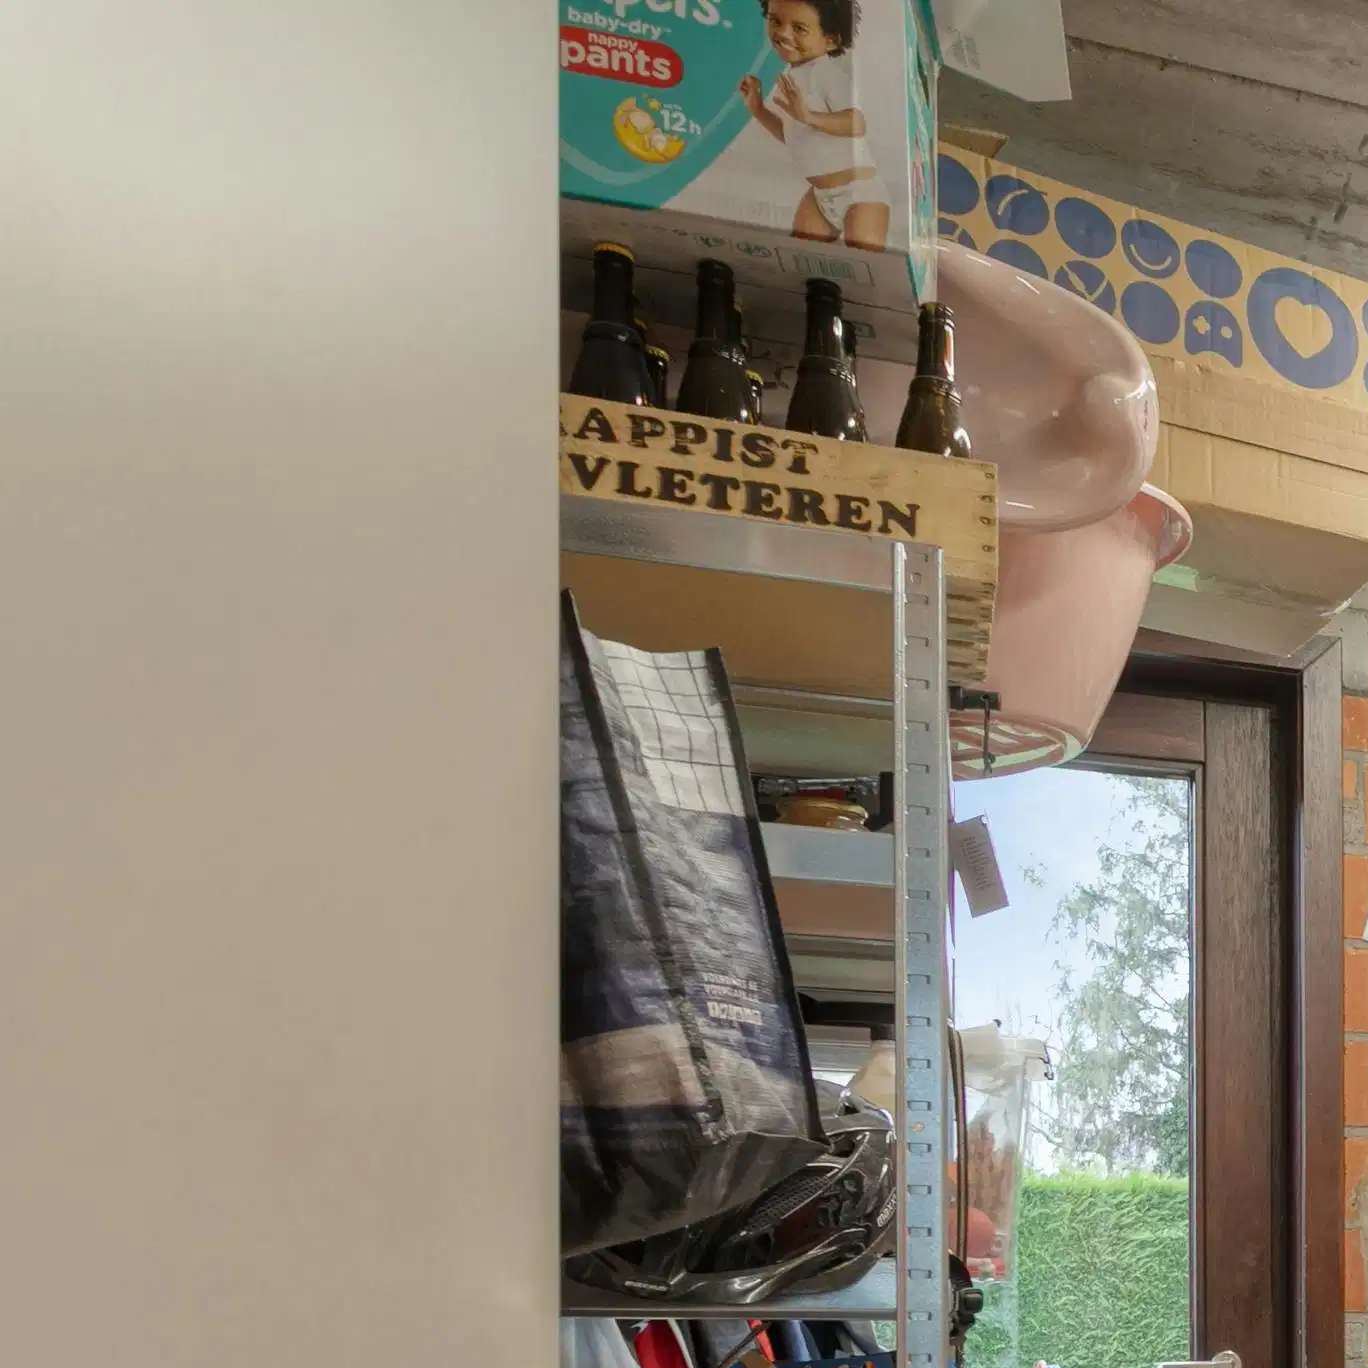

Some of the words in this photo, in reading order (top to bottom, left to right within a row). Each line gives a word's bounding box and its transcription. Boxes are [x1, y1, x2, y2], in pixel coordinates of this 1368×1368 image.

[587, 32, 638, 52] nappy
[559, 40, 672, 81] pants
[660, 108, 687, 133] 12
[568, 452, 921, 538] VLETEREN
